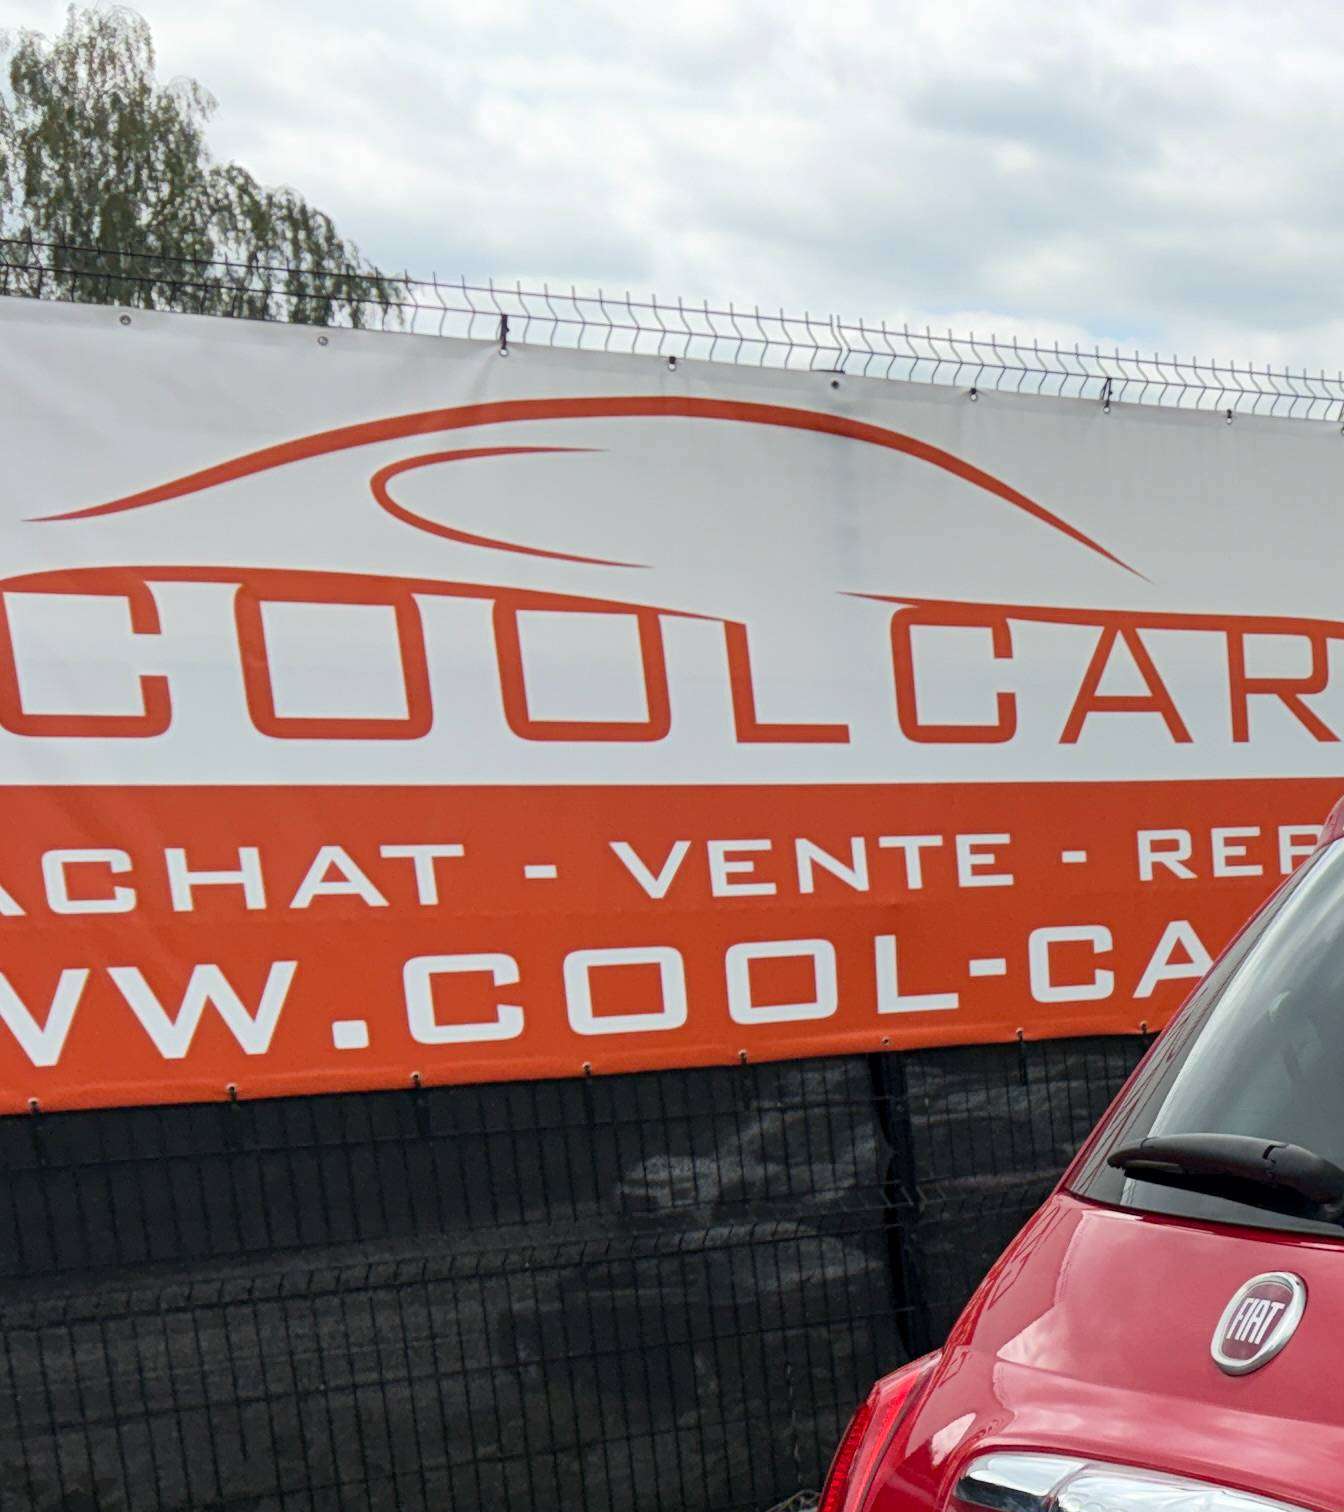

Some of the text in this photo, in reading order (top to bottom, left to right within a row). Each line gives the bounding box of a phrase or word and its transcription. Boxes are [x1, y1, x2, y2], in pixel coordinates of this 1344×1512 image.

[0, 566, 850, 743] COOL
[0, 844, 465, 917] CHAT
[608, 832, 1015, 900] VENTE
[1226, 1297, 1286, 1345] FIAT
